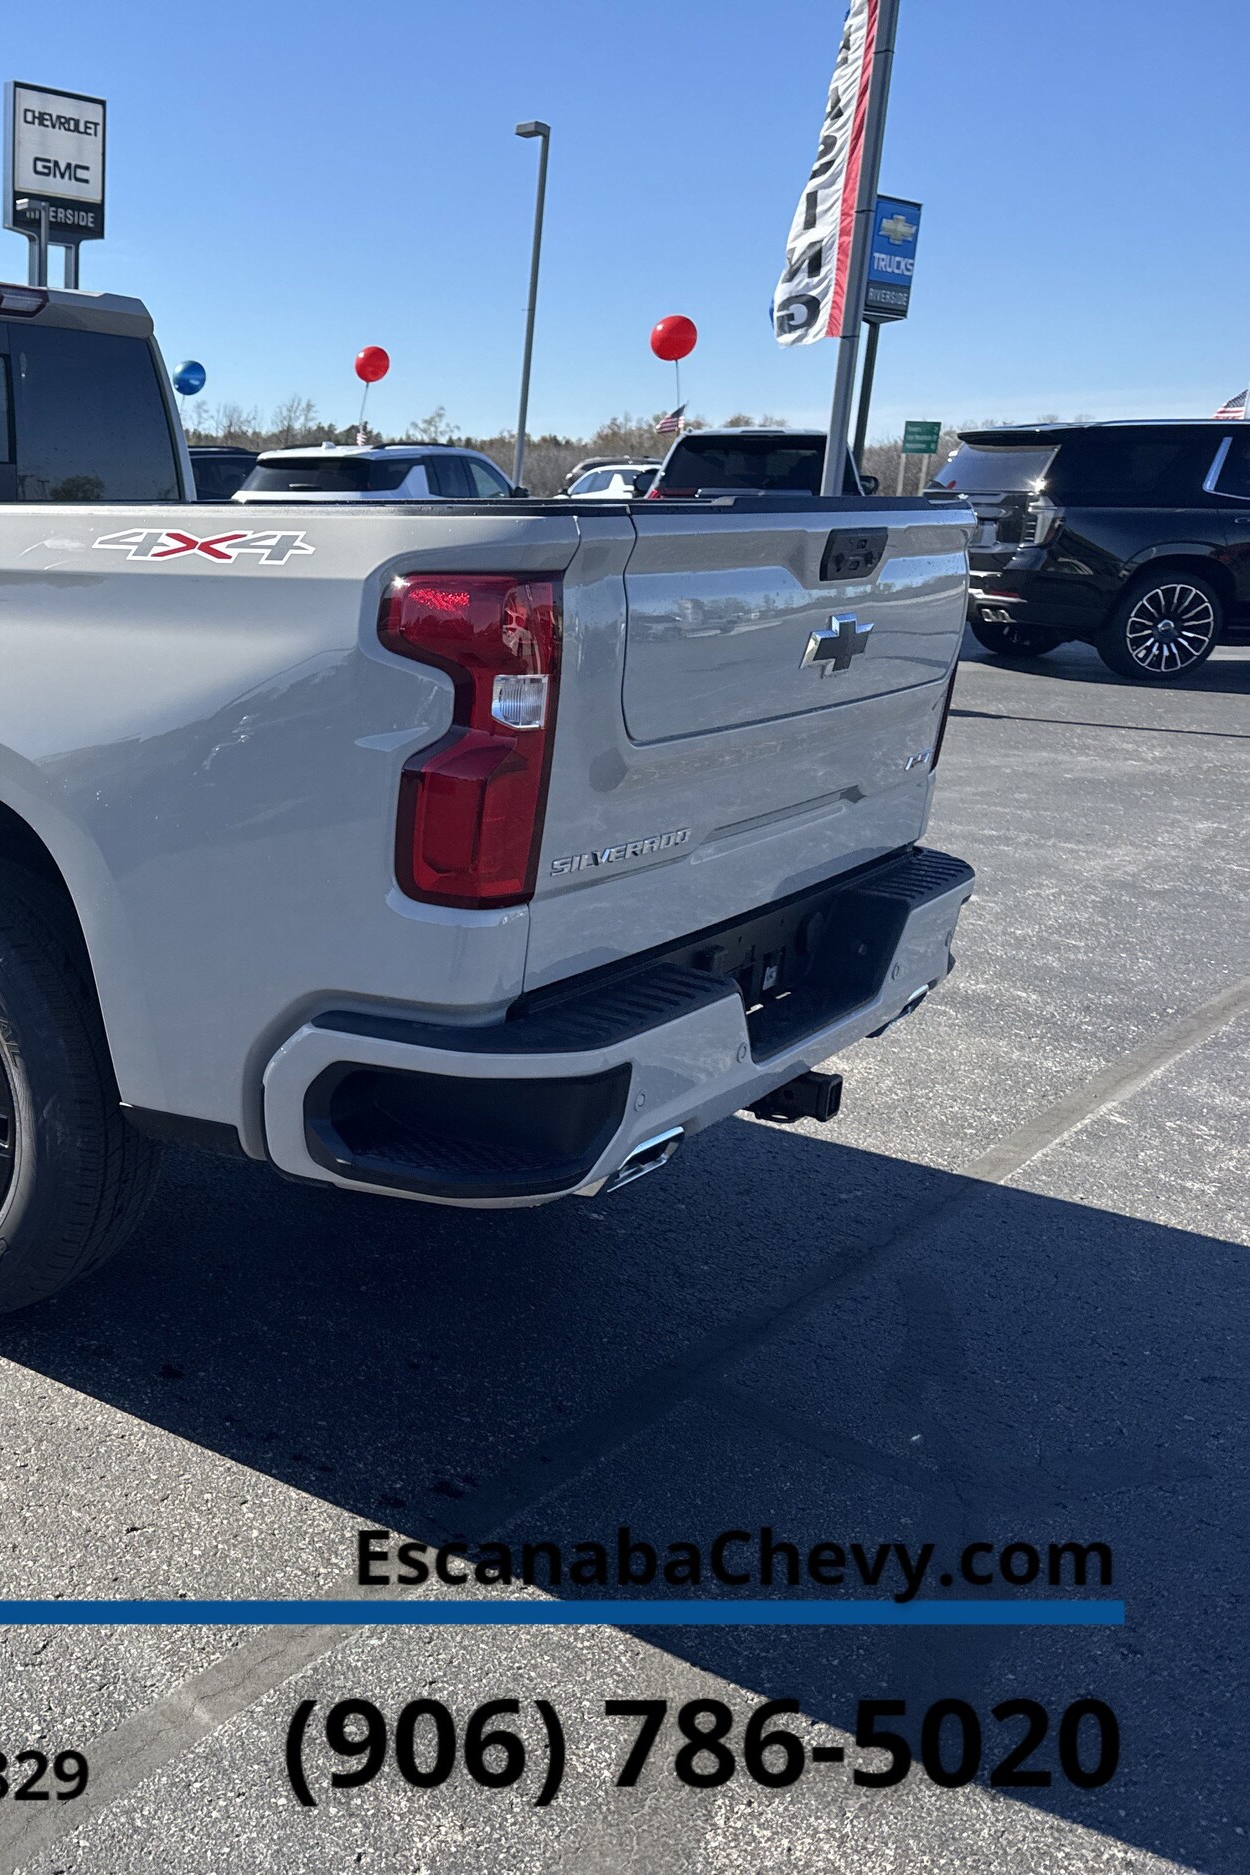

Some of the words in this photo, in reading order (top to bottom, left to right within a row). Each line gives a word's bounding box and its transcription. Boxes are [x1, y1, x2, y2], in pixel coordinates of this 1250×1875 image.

[23, 108, 101, 138] CHEVROLET
[33, 156, 91, 185] GMC
[25, 205, 95, 228] IERSIDE
[873, 252, 914, 276] TRUCKS
[869, 287, 908, 306] RIVERSIDE
[550, 827, 692, 877] SILVERADO
